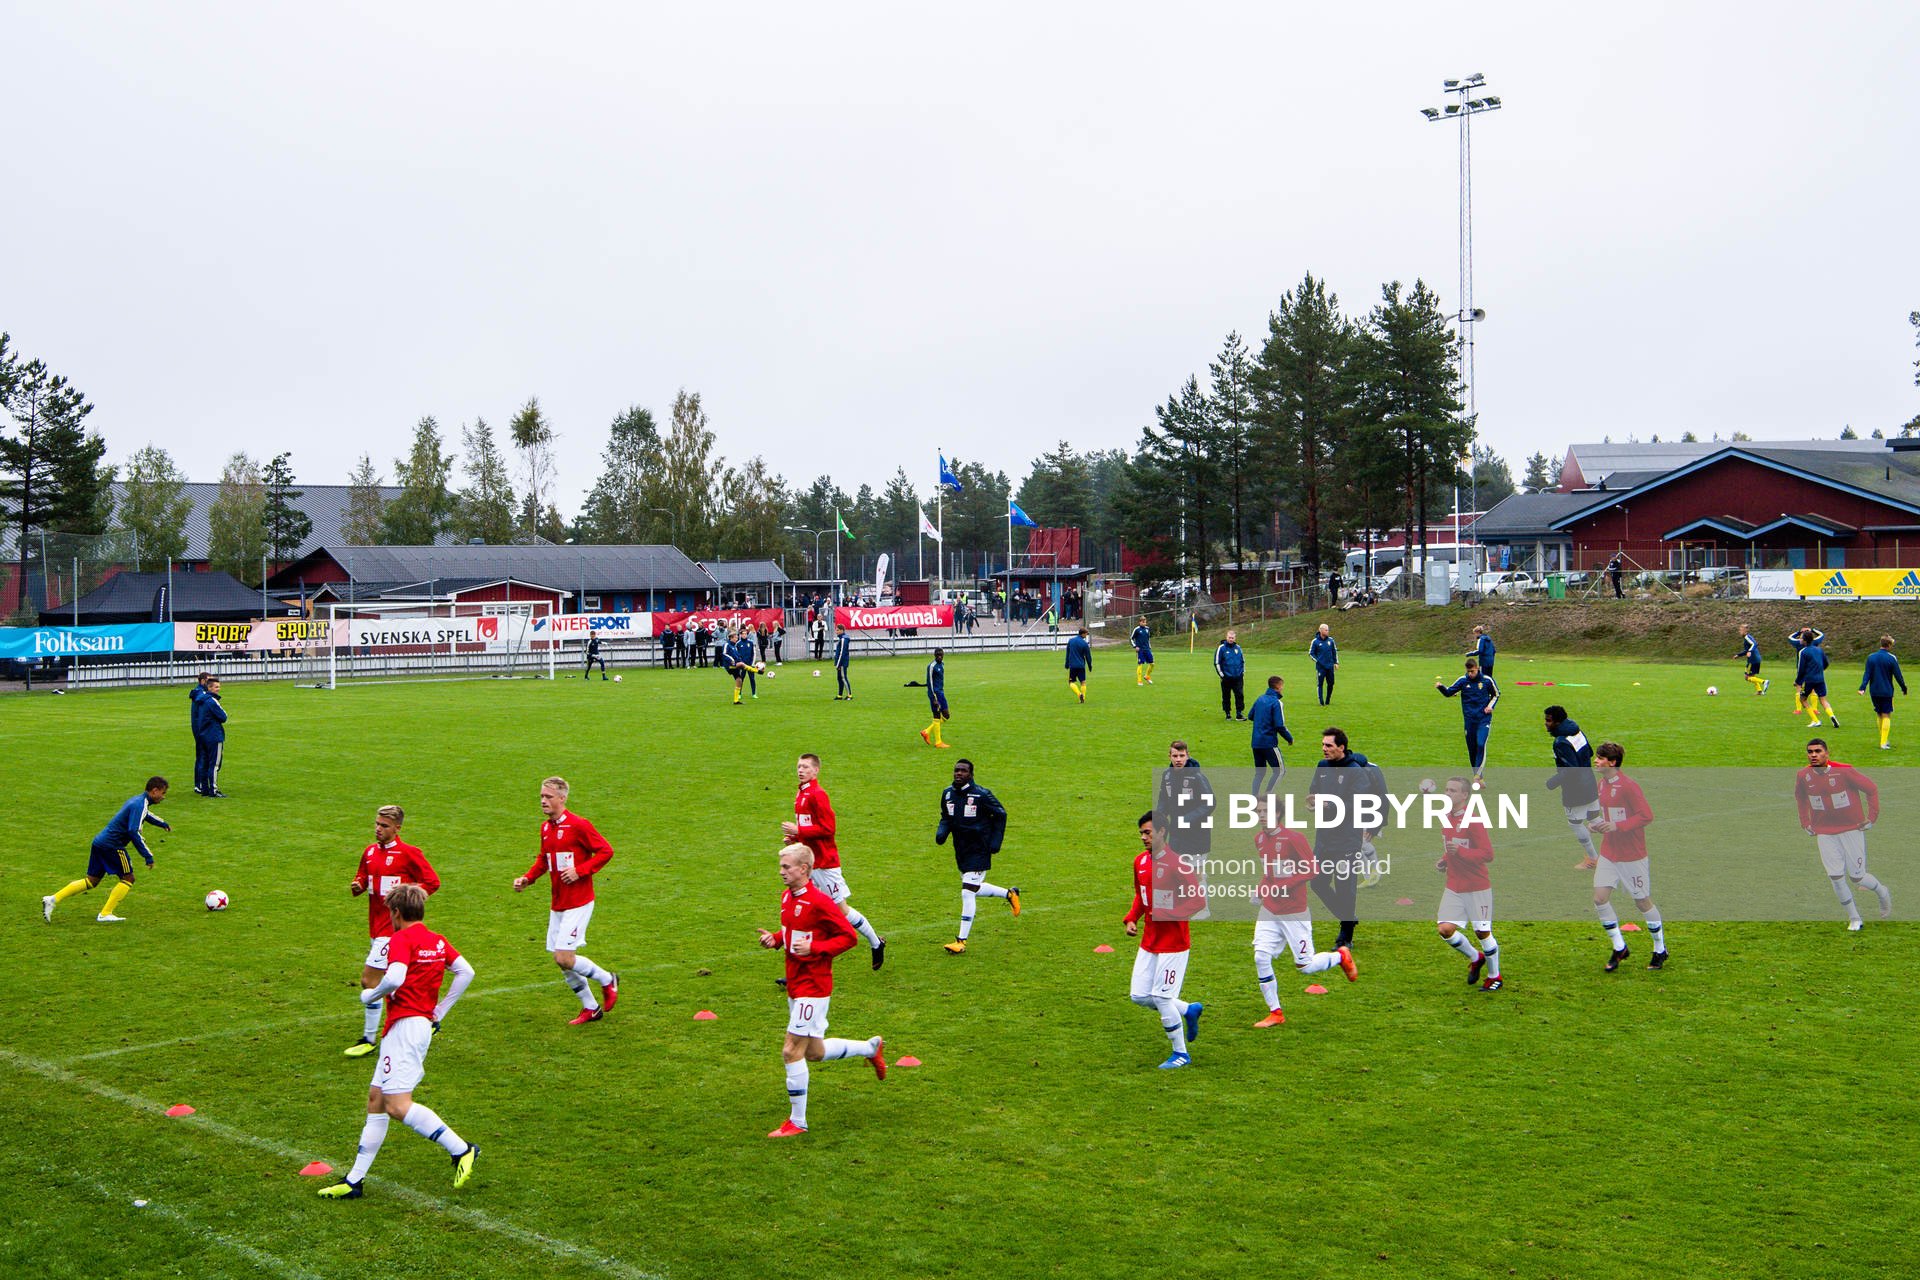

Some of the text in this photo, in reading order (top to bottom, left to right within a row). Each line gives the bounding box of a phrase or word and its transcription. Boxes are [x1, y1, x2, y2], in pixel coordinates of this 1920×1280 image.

[1820, 586, 1853, 595] adidas
[1893, 585, 1920, 595] adida
[277, 621, 329, 640] SPORT
[551, 616, 631, 631] NTERSPORT
[196, 623, 252, 643] SPORT
[360, 630, 473, 646] SVENSKA SPEL
[34, 631, 124, 654] Folksam
[279, 640, 328, 648] BLADET
[1857, 857, 1863, 868] 9
[827, 883, 839, 895] 14
[1632, 875, 1644, 888] 15
[1480, 905, 1489, 920] 17
[570, 927, 578, 939] 4
[381, 943, 390, 956] 6
[1299, 939, 1307, 954] 2
[1164, 969, 1176, 985] 18
[799, 1002, 814, 1021] 10
[383, 1055, 392, 1074] 3
